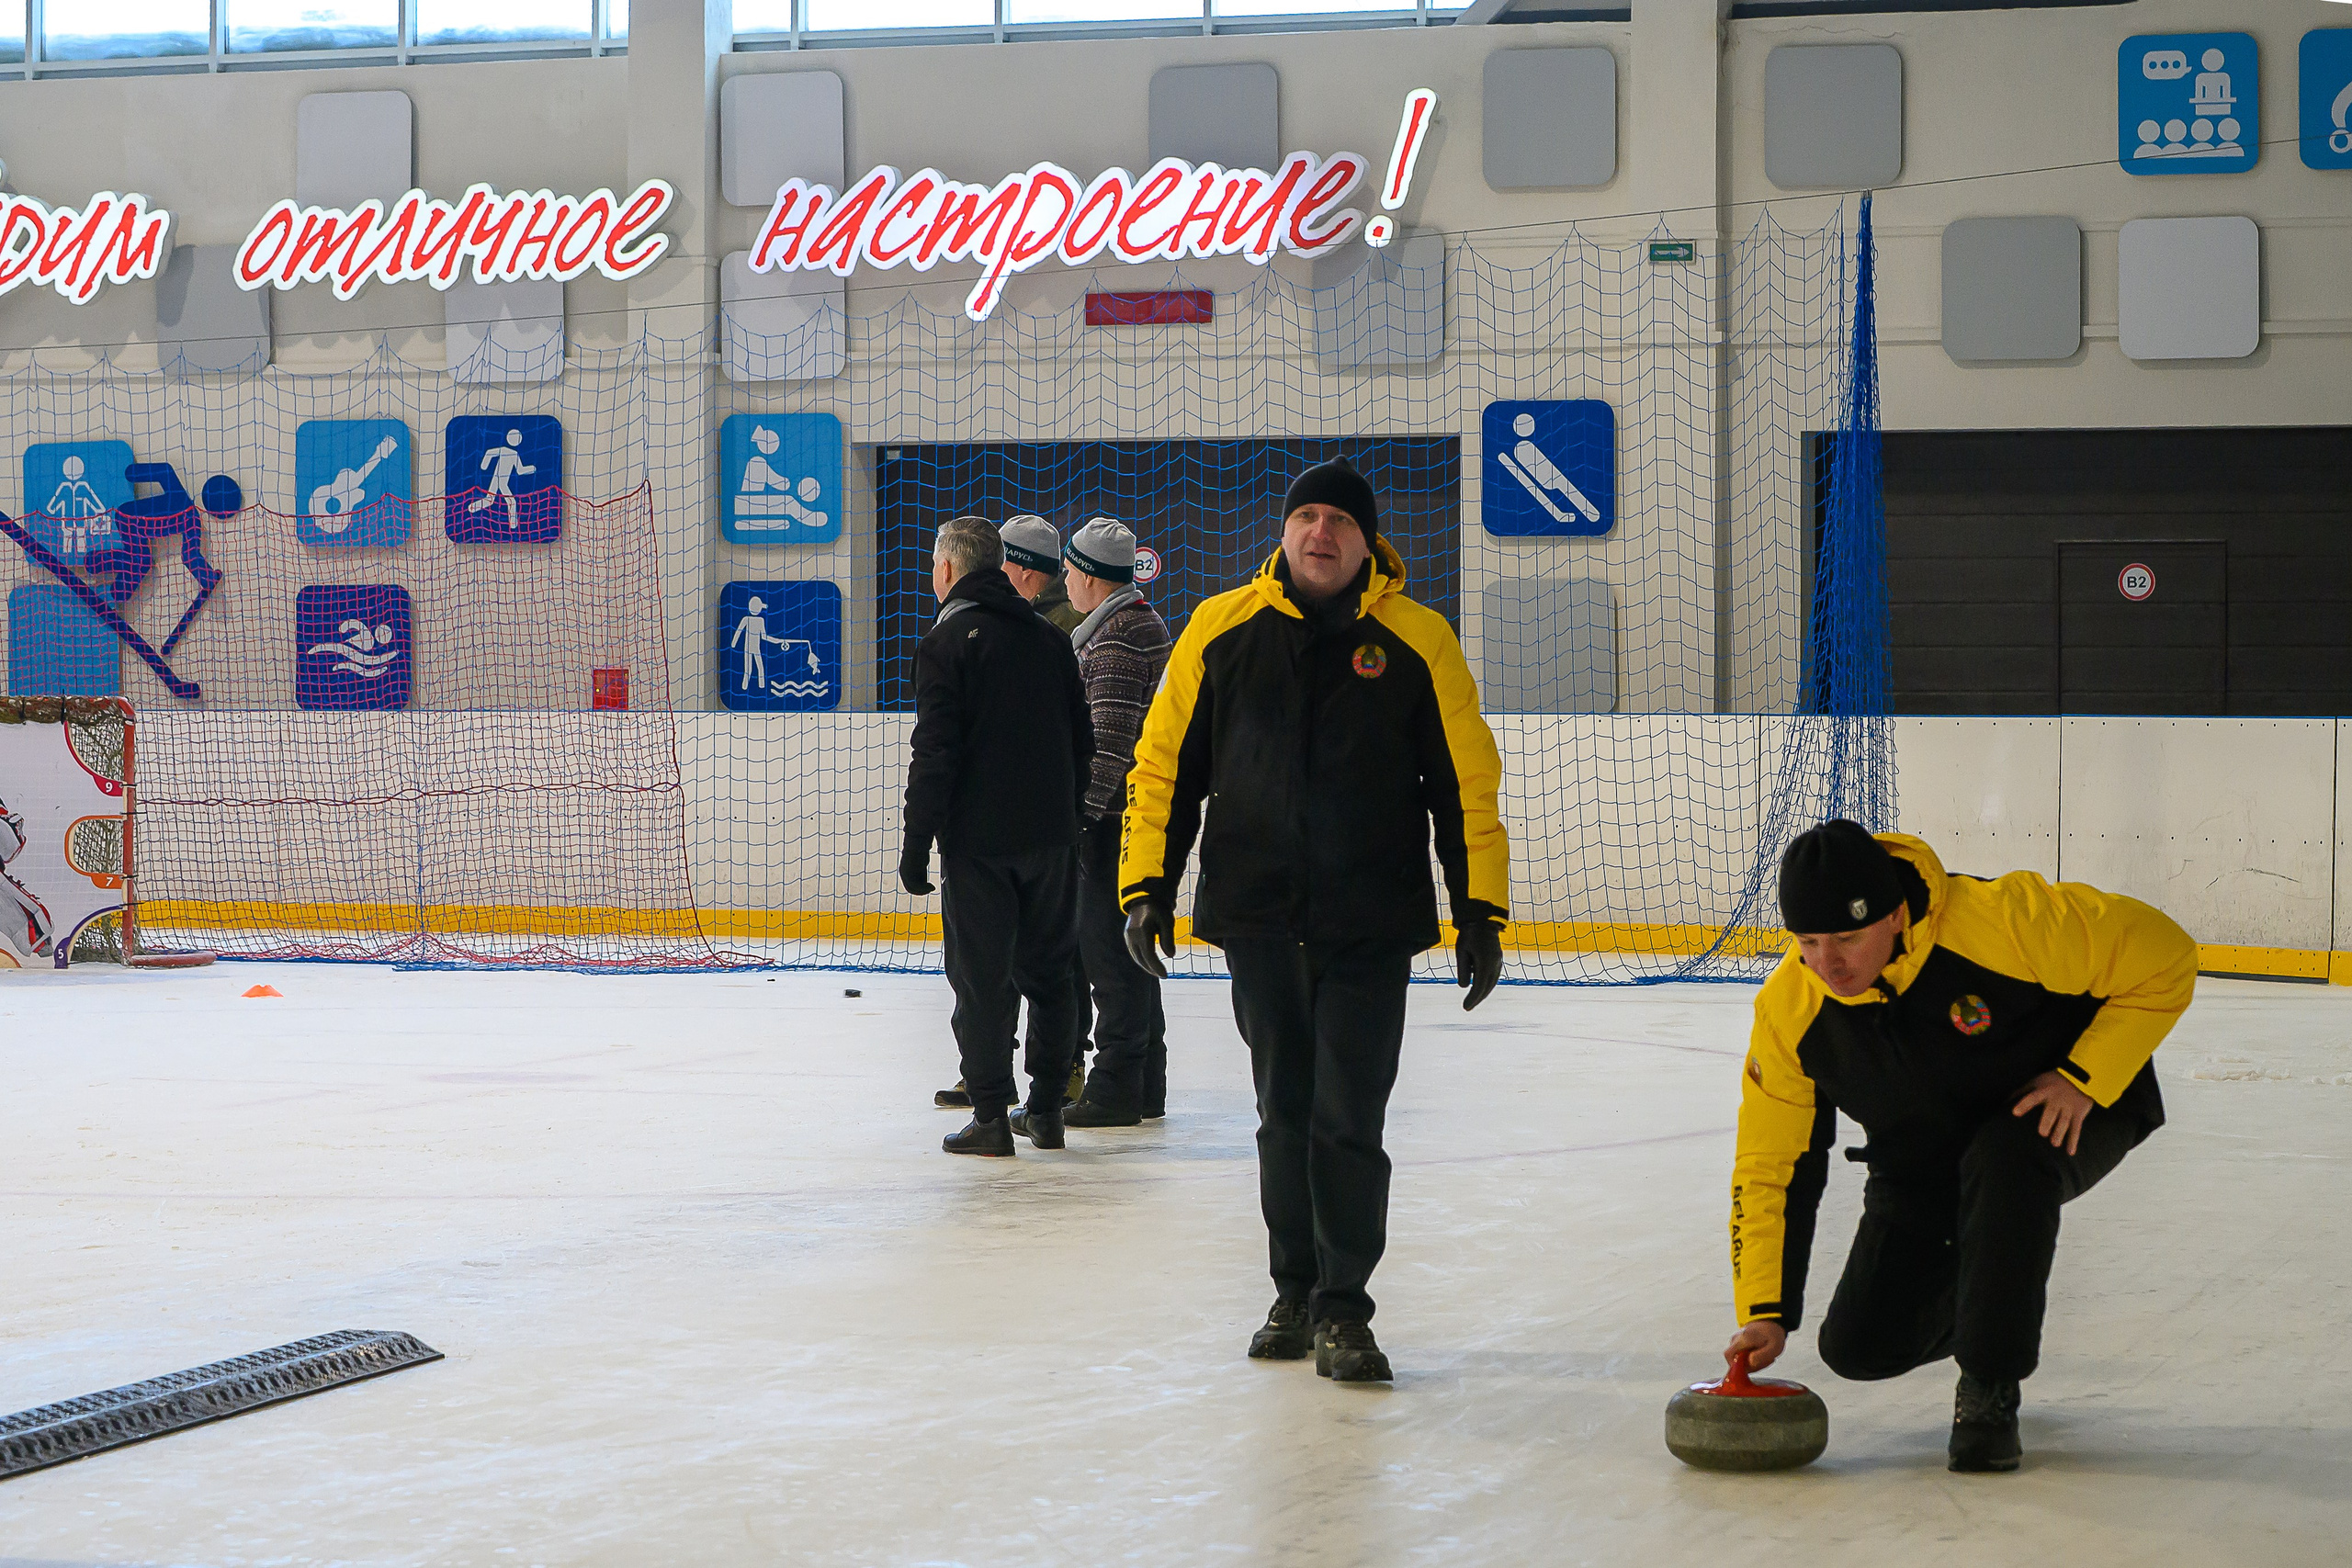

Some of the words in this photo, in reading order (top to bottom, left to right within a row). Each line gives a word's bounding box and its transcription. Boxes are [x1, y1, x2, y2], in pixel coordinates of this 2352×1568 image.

[0, 200, 162, 299] дим
[241, 187, 665, 292] отличное
[755, 97, 1429, 313] настроение!
[1003, 547, 1034, 562] ЛАРУСЬ
[1066, 547, 1095, 571] БЕЛАРУСЬ
[105, 782, 113, 793] 9
[1121, 783, 1137, 865] BEARUS
[106, 876, 114, 887] 7
[57, 948, 64, 960] 5
